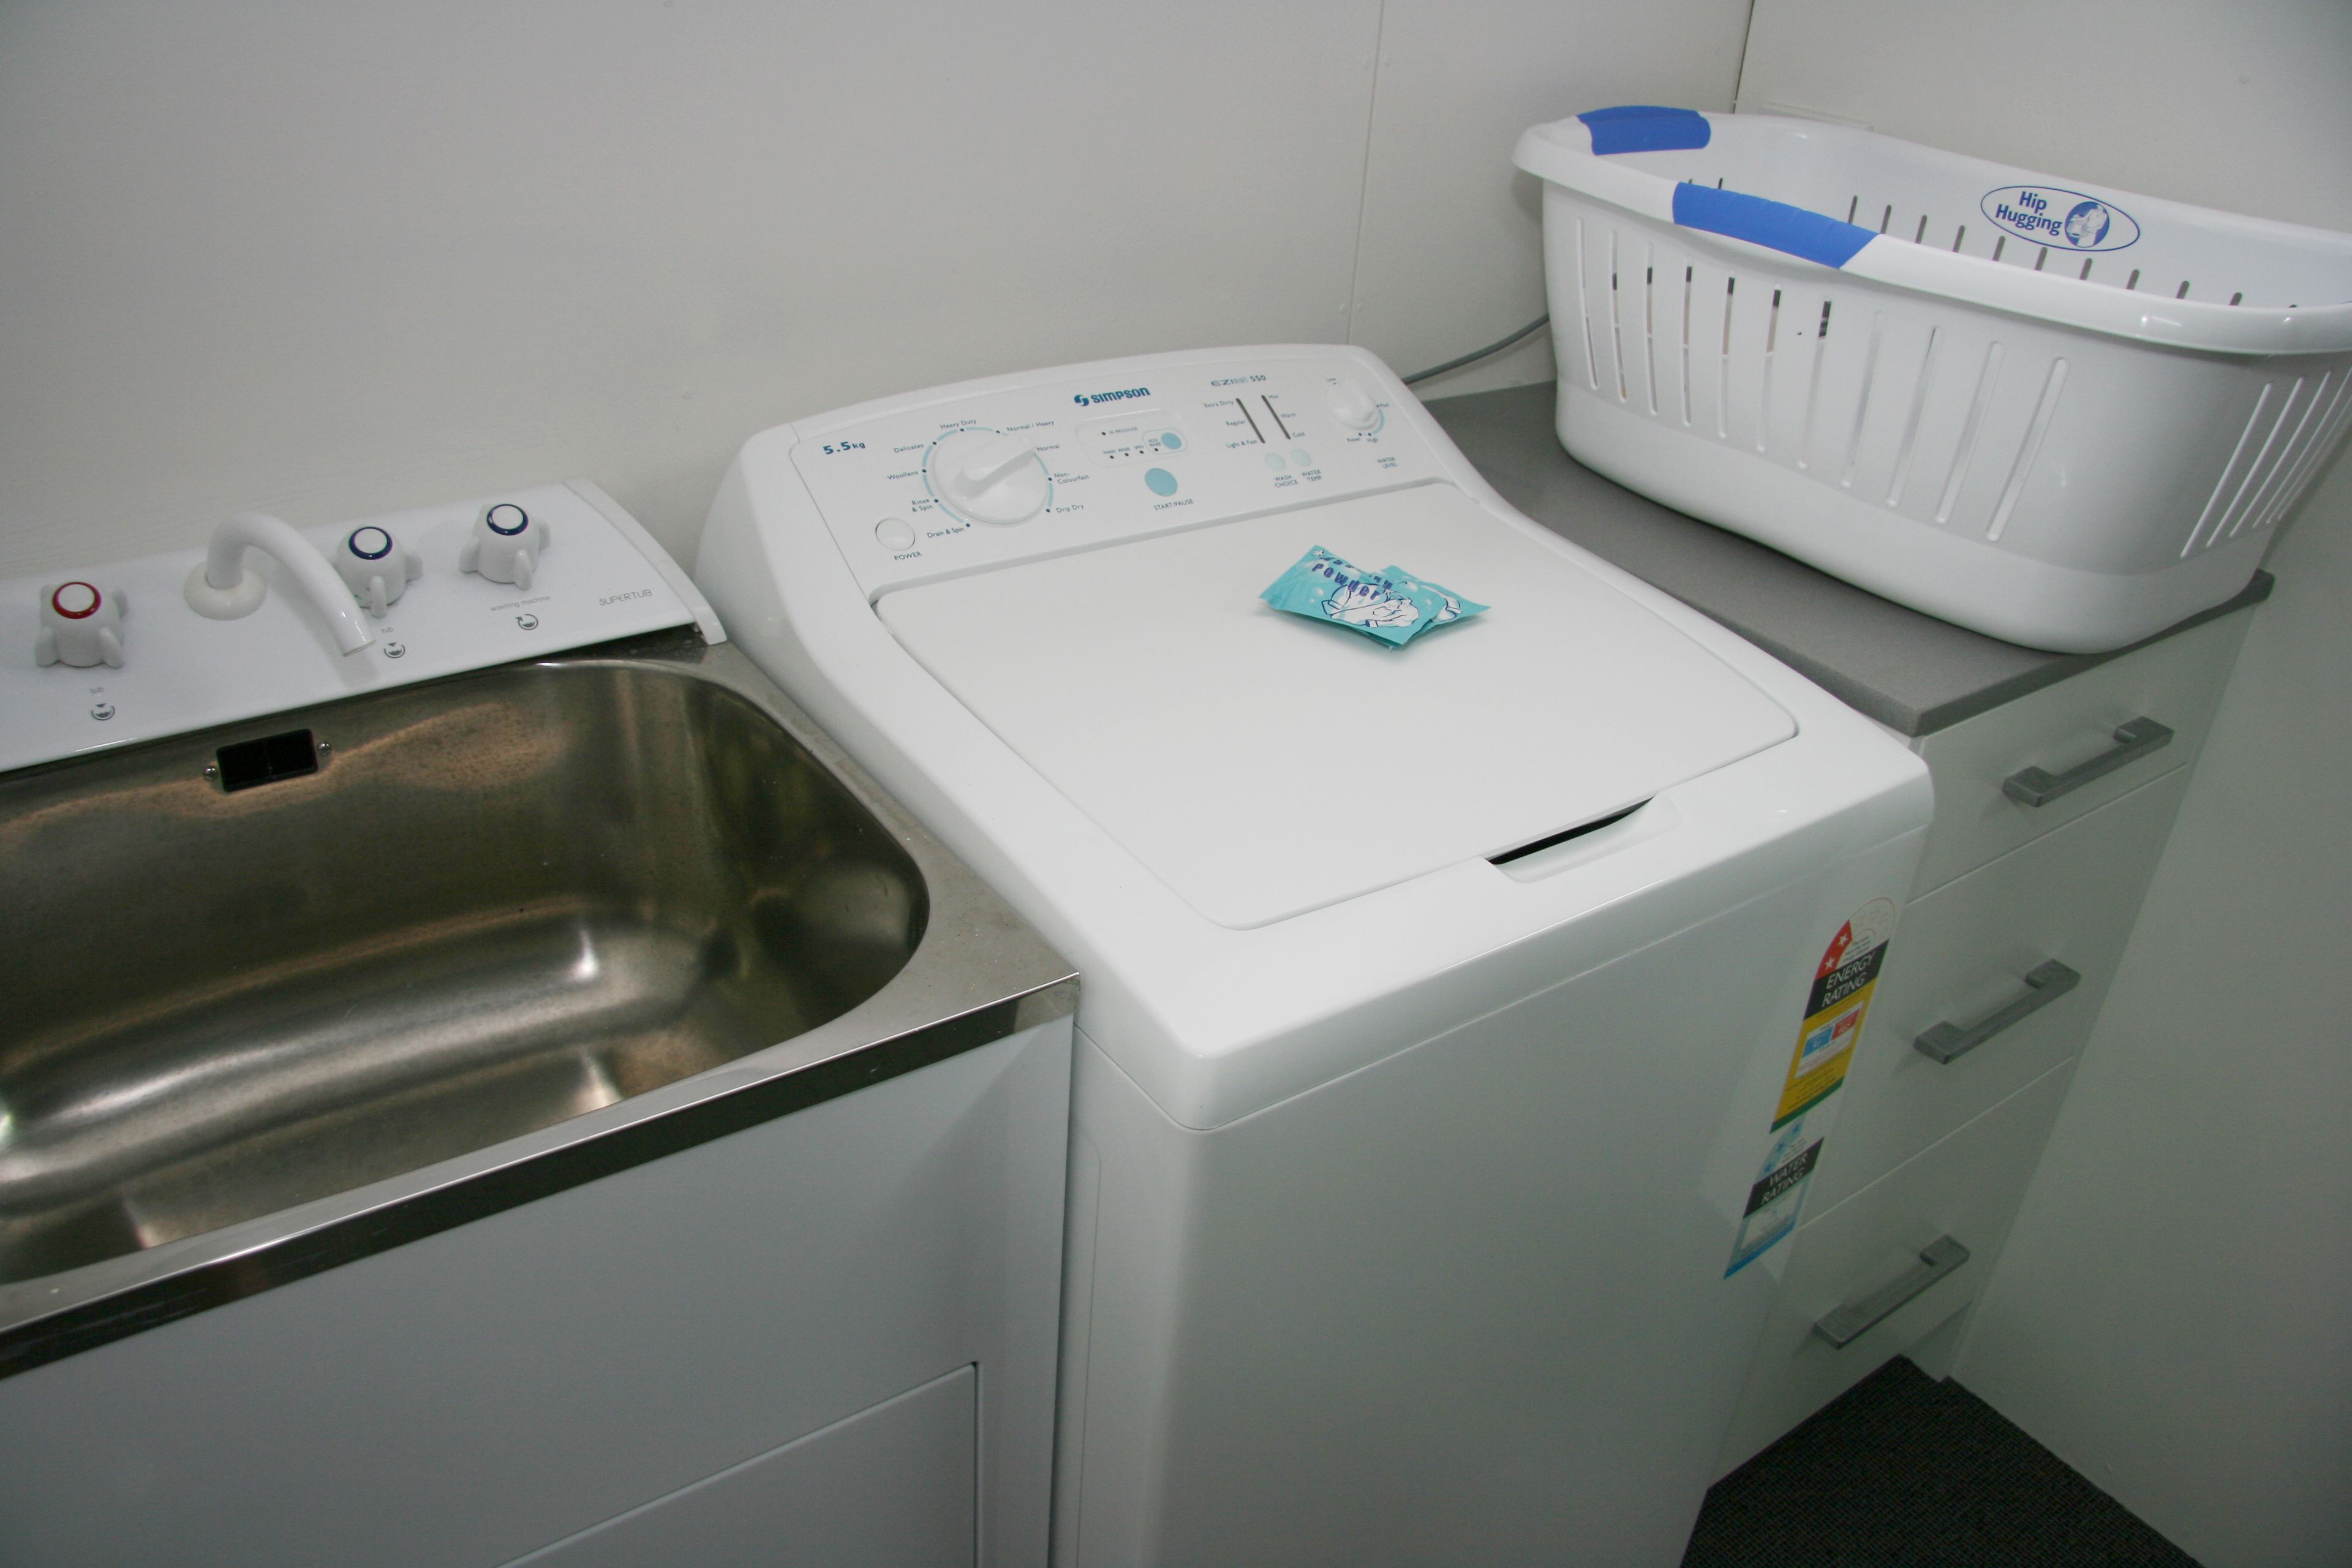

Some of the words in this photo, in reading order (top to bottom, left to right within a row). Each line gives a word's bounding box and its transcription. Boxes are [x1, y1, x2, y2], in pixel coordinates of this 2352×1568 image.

[2019, 191, 2047, 214] Hip
[1995, 203, 2062, 236] Hugging
[1090, 387, 1151, 403] SIMPSON
[894, 443, 924, 453] Delicates
[1036, 443, 1060, 451] Normal
[887, 470, 919, 480] Woollens
[1057, 475, 1090, 484] Colourfast
[1153, 499, 1194, 510] START/PAUSE
[894, 551, 922, 560] POWER
[490, 600, 520, 612] washing
[521, 595, 551, 606] machine
[599, 589, 652, 606] SUPERTUB
[1826, 951, 1876, 990] ENERGY
[1822, 972, 1867, 1008] RATING
[1769, 1153, 1809, 1186] WATER
[1761, 1167, 1804, 1205] RATING
